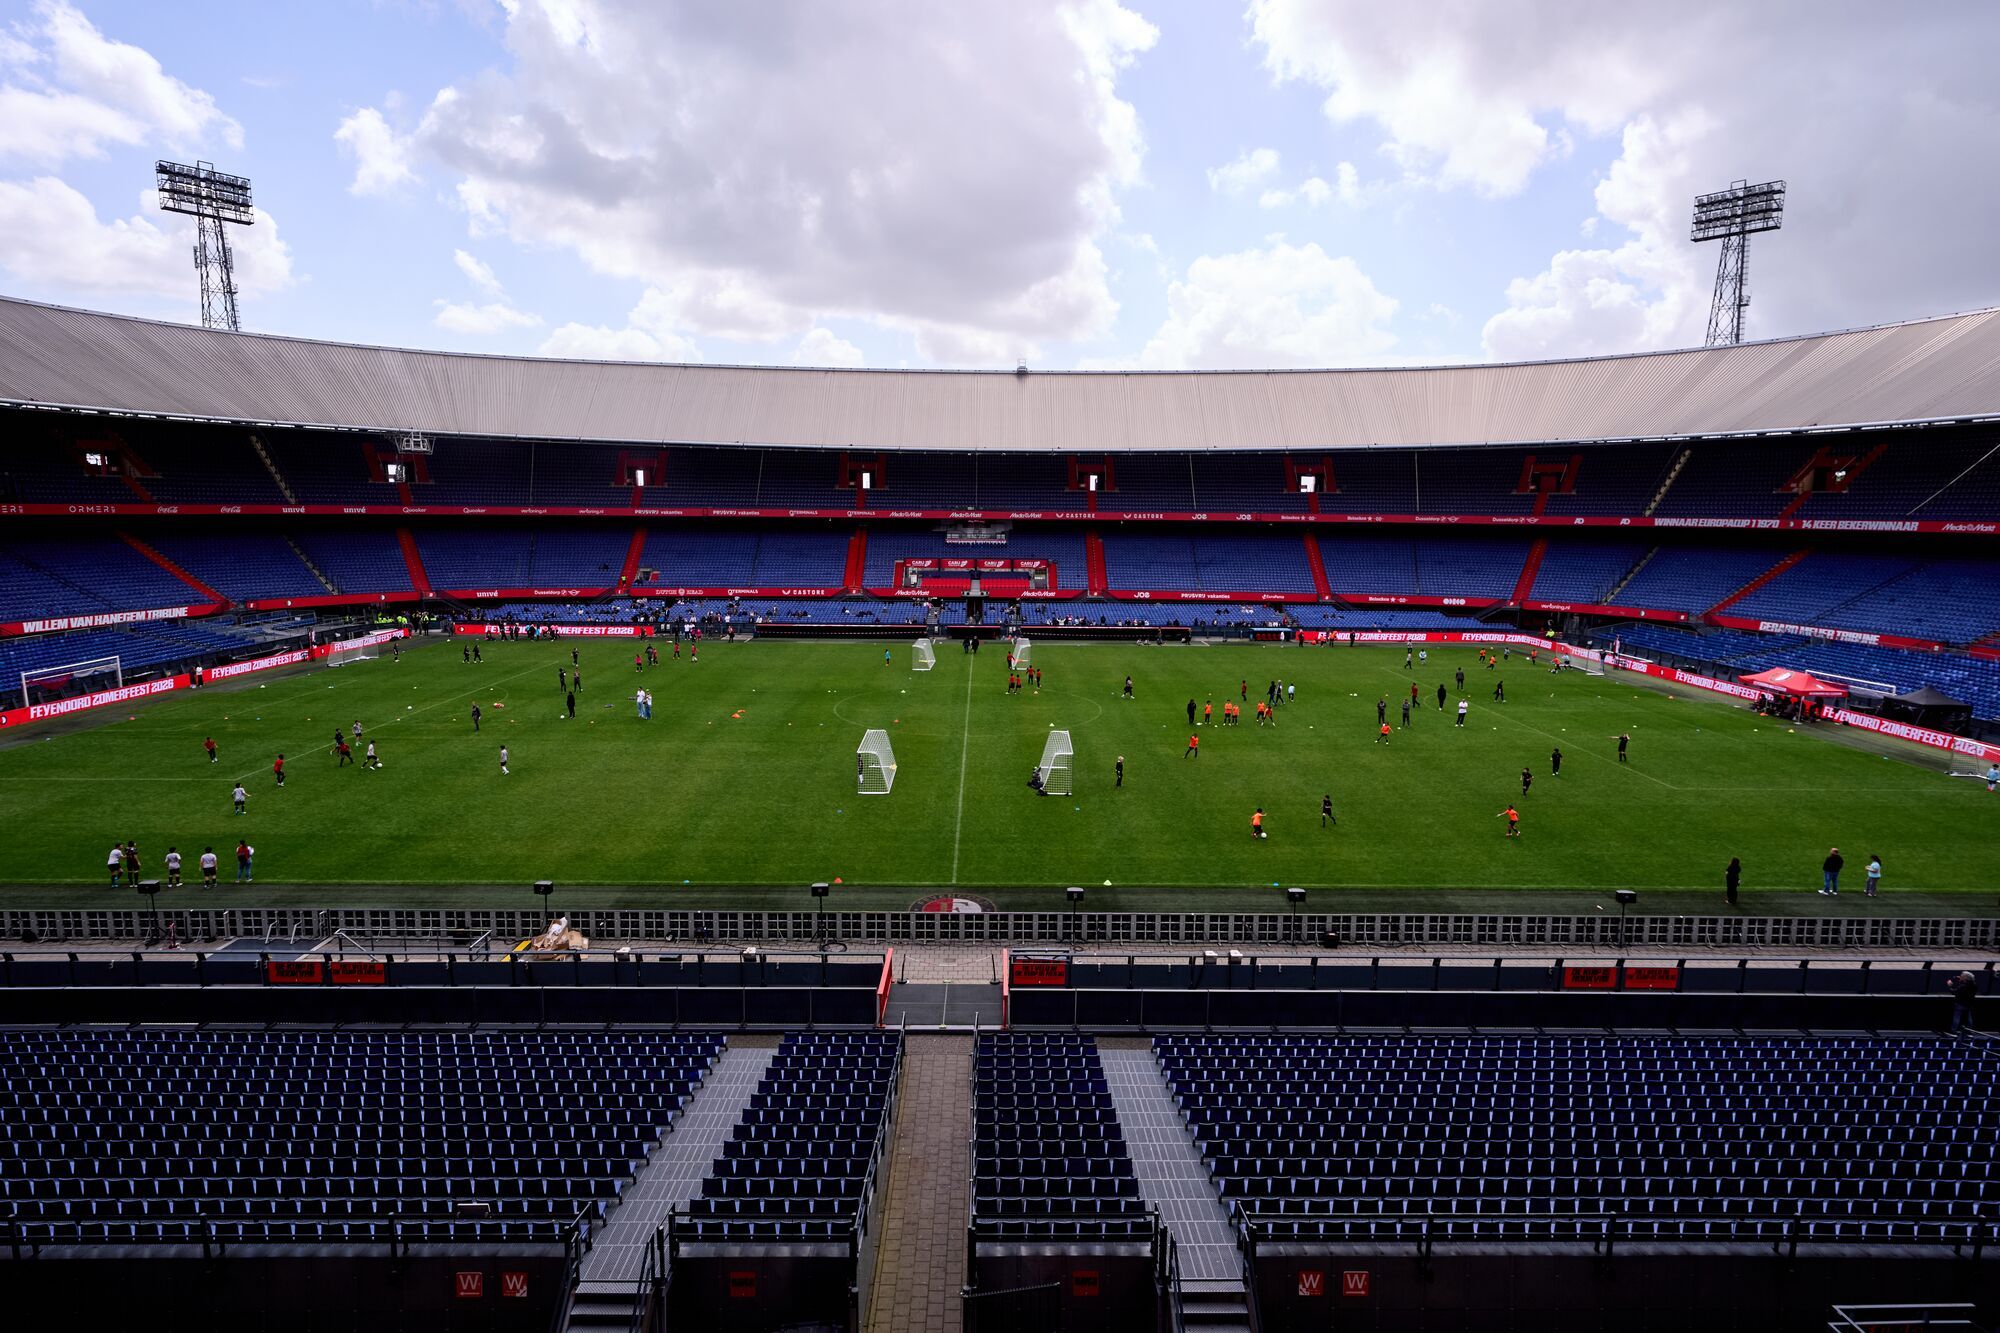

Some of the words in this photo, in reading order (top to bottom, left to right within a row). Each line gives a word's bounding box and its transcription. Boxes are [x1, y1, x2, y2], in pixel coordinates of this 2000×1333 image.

[1654, 518, 1699, 527] WINNAAR
[1698, 518, 1750, 528] EUROPACUP
[1756, 519, 1780, 528] 1970
[1801, 520, 1812, 529] 14
[1812, 520, 1838, 529] KEER
[1837, 520, 1919, 531] BEKERWINNAAR
[22, 618, 68, 633] WILLEM
[69, 616, 94, 628] VAN
[94, 611, 146, 626] HANEGEM
[147, 607, 188, 620] TRIBUNE
[607, 627, 634, 635] 2026
[1360, 632, 1407, 640] ZOMERFEEST
[1407, 633, 1426, 641] 2026
[1759, 621, 1799, 635] GERARD
[1835, 629, 1880, 645] TRIBUNE
[1461, 633, 1505, 641] FEYENOORD
[1505, 634, 1540, 647] ZOMERFEEST
[1540, 639, 1552, 649] 2026
[211, 661, 251, 678] FEYENOORD
[252, 652, 292, 670] ZOMERFEEST
[1675, 670, 1714, 688] FEYENOORD
[1713, 680, 1760, 700] ZOMERFEEST
[30, 696, 91, 719] FEYENOORD
[92, 684, 151, 707] ZOMERFEEST
[151, 678, 174, 693] 2026
[1880, 719, 1953, 748] ZOMERFEEST
[459, 1275, 479, 1290] W
[505, 1275, 524, 1290] W
[1302, 1274, 1321, 1289] W
[1346, 1274, 1366, 1289] W
